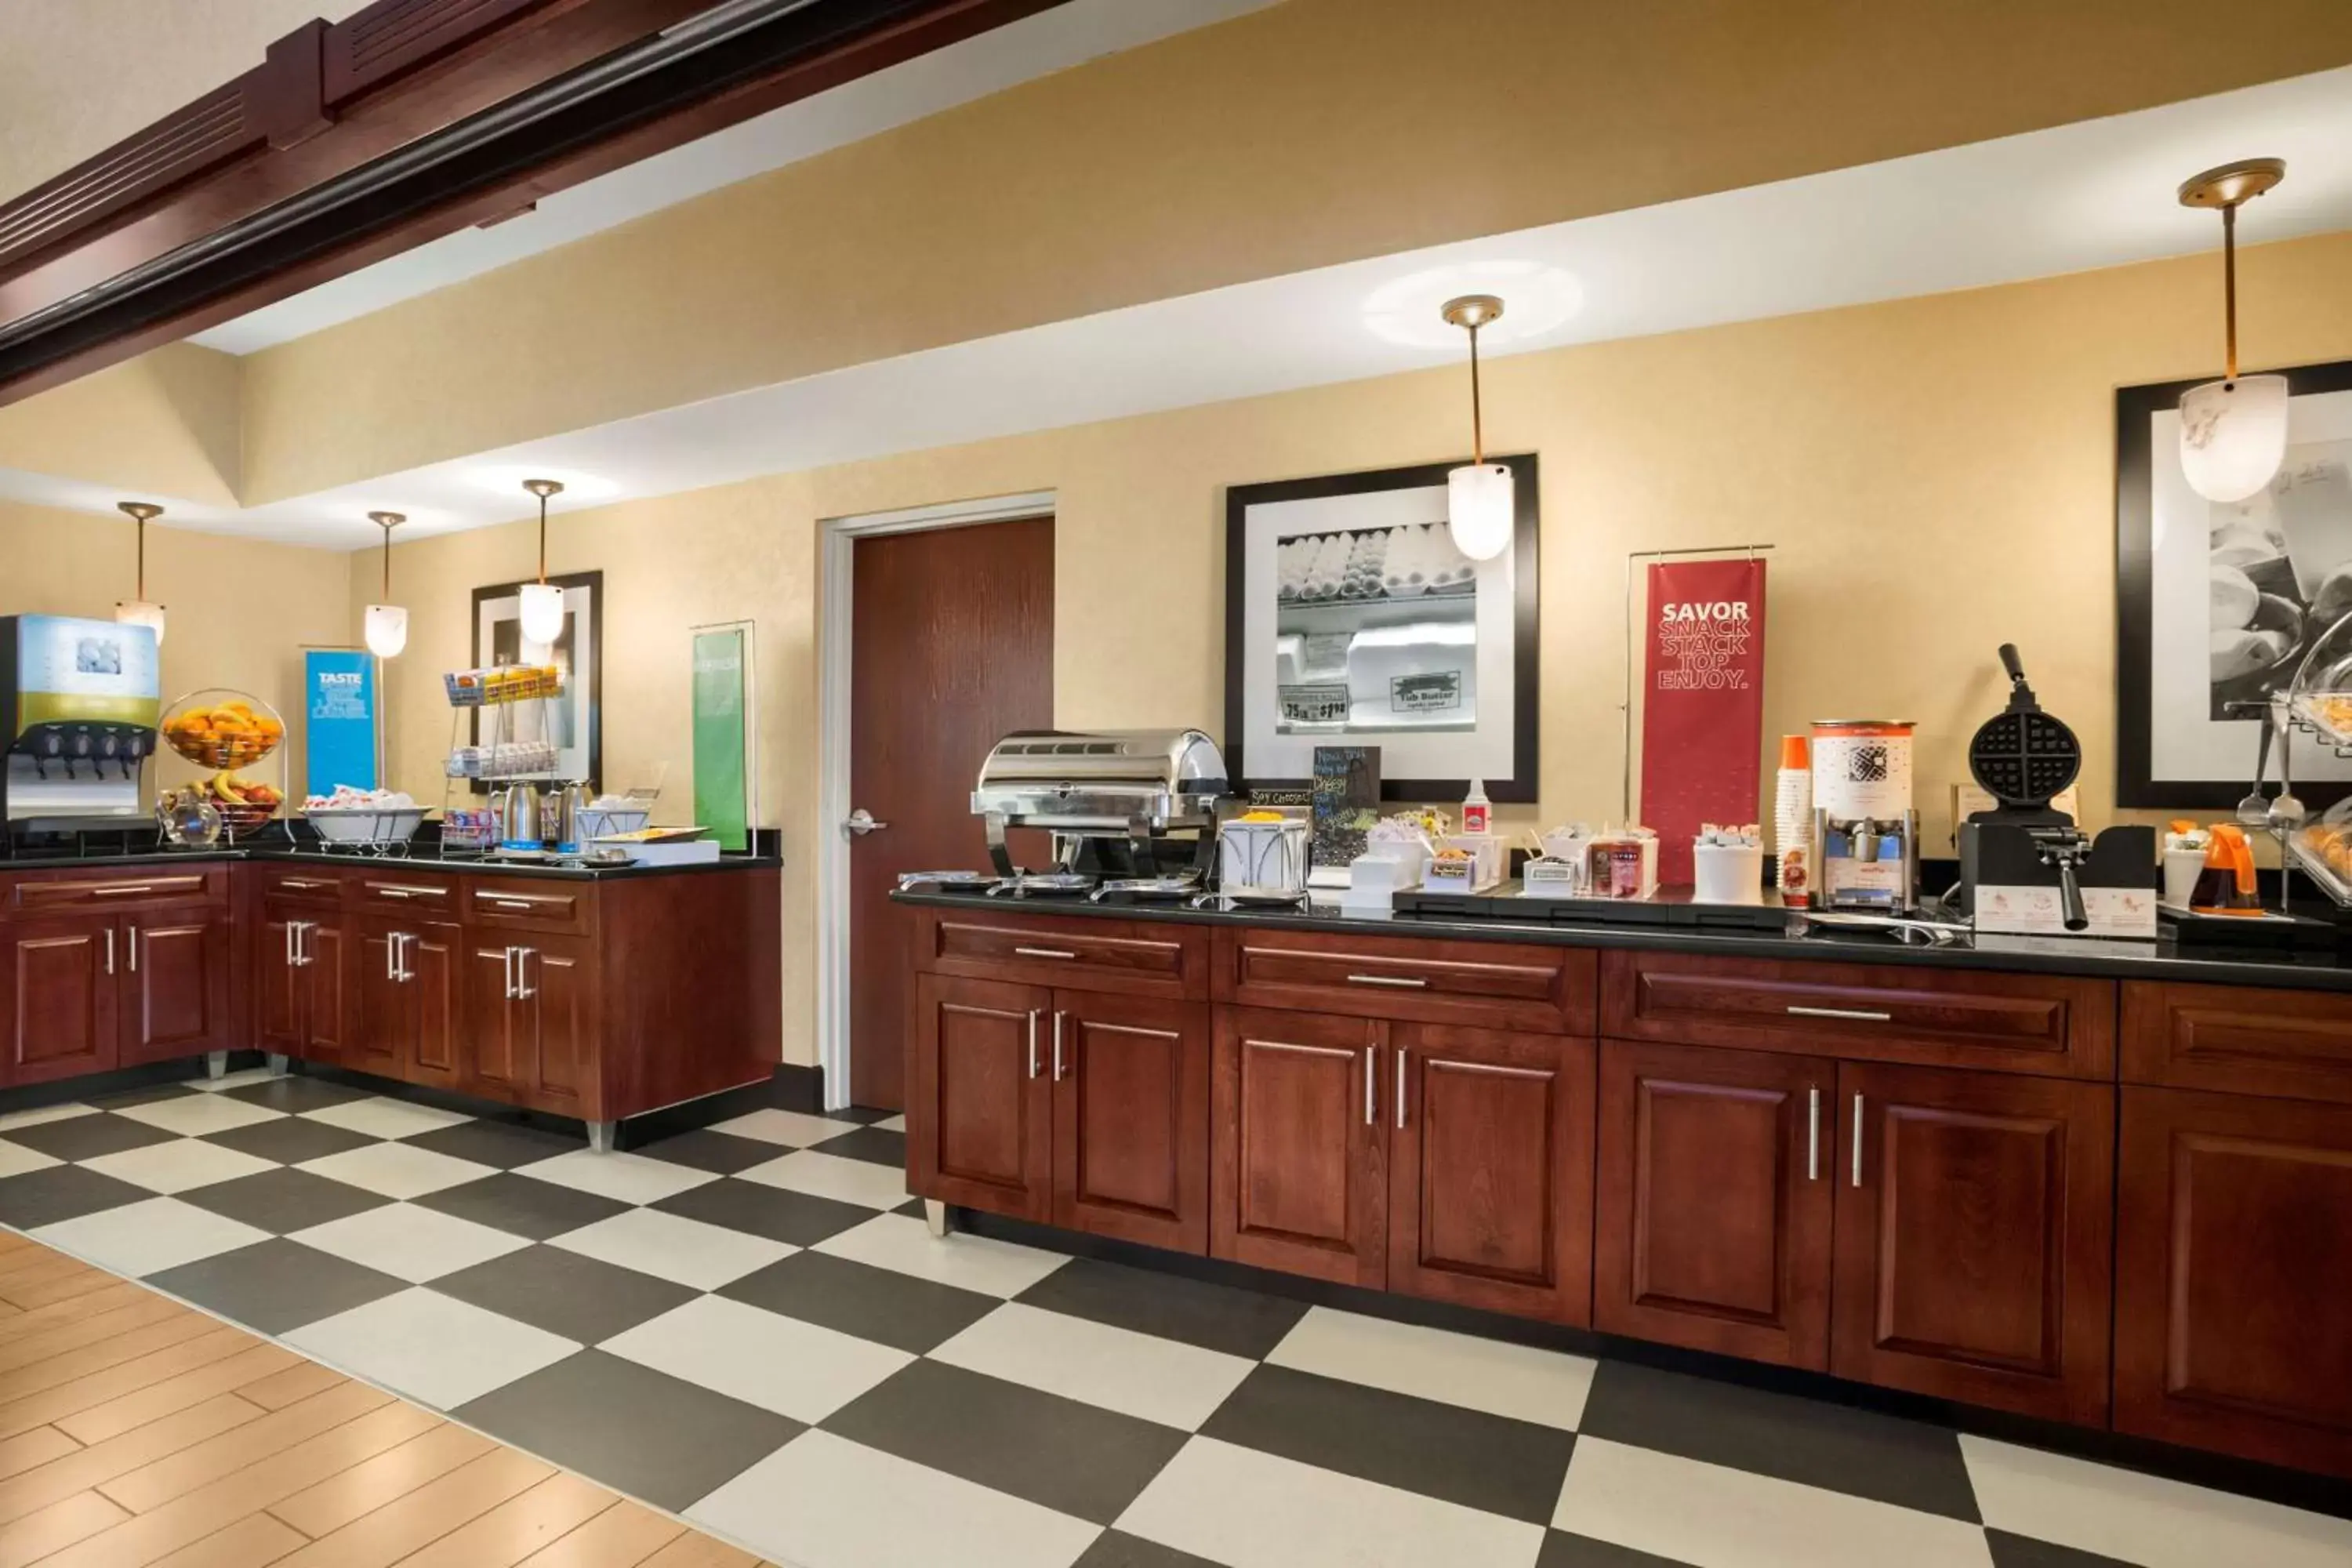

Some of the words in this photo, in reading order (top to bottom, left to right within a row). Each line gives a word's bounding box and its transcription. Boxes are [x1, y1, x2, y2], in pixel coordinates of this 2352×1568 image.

[1662, 601, 1748, 621] SAVOR
[1658, 617, 1751, 638] SNACK
[1661, 636, 1748, 655] STACK
[1677, 652, 1730, 673] TOP
[318, 673, 363, 684] TASTE
[1657, 670, 1749, 689] ENJOY.
